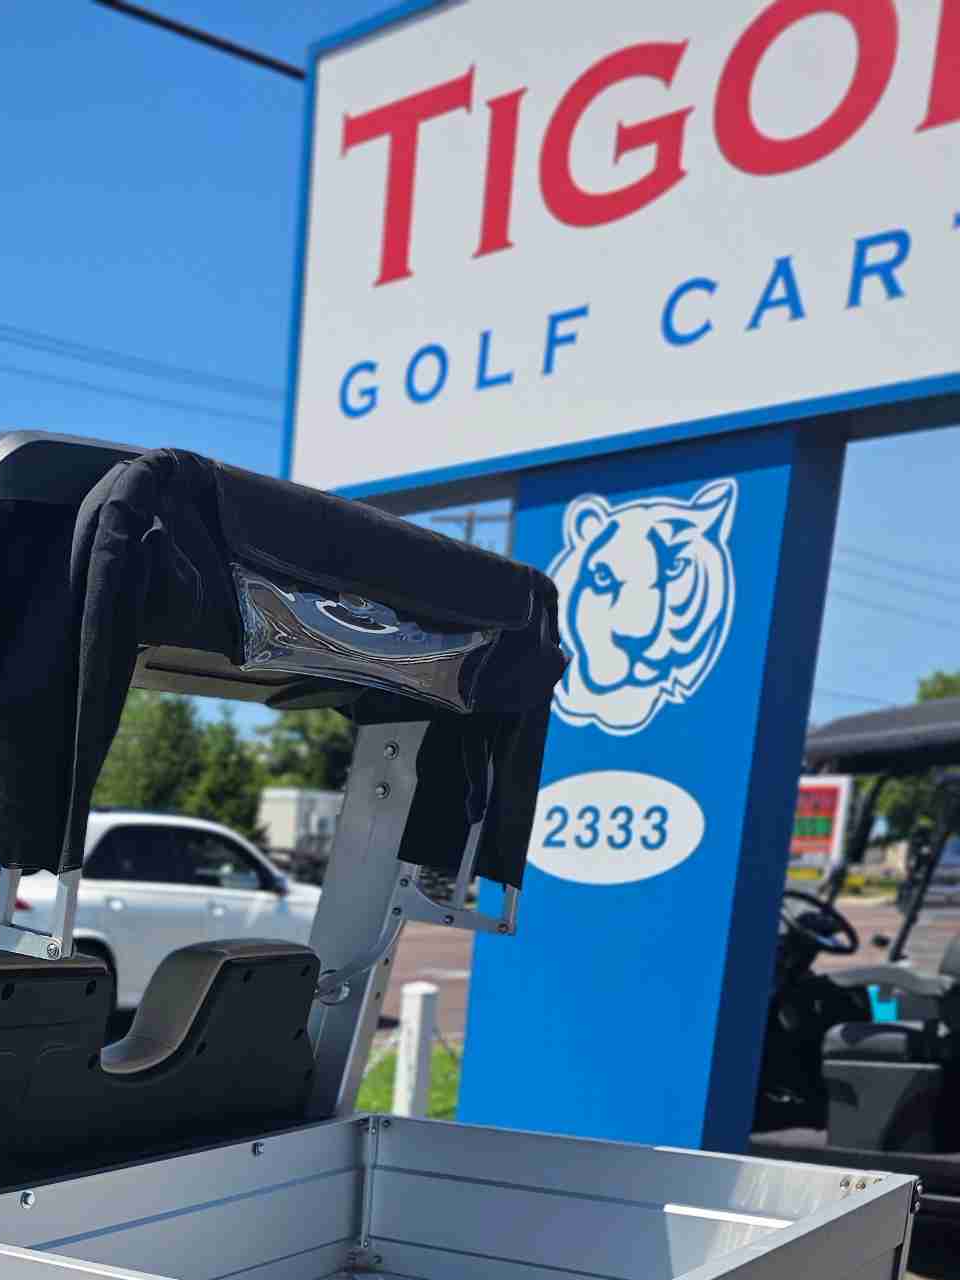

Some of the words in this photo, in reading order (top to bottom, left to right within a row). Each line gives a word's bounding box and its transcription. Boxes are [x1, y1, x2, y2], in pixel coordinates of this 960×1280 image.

[342, 0, 960, 288] TIGO
[338, 304, 590, 420] GOLF
[660, 211, 960, 347] CAR
[542, 805, 669, 851] 2333
